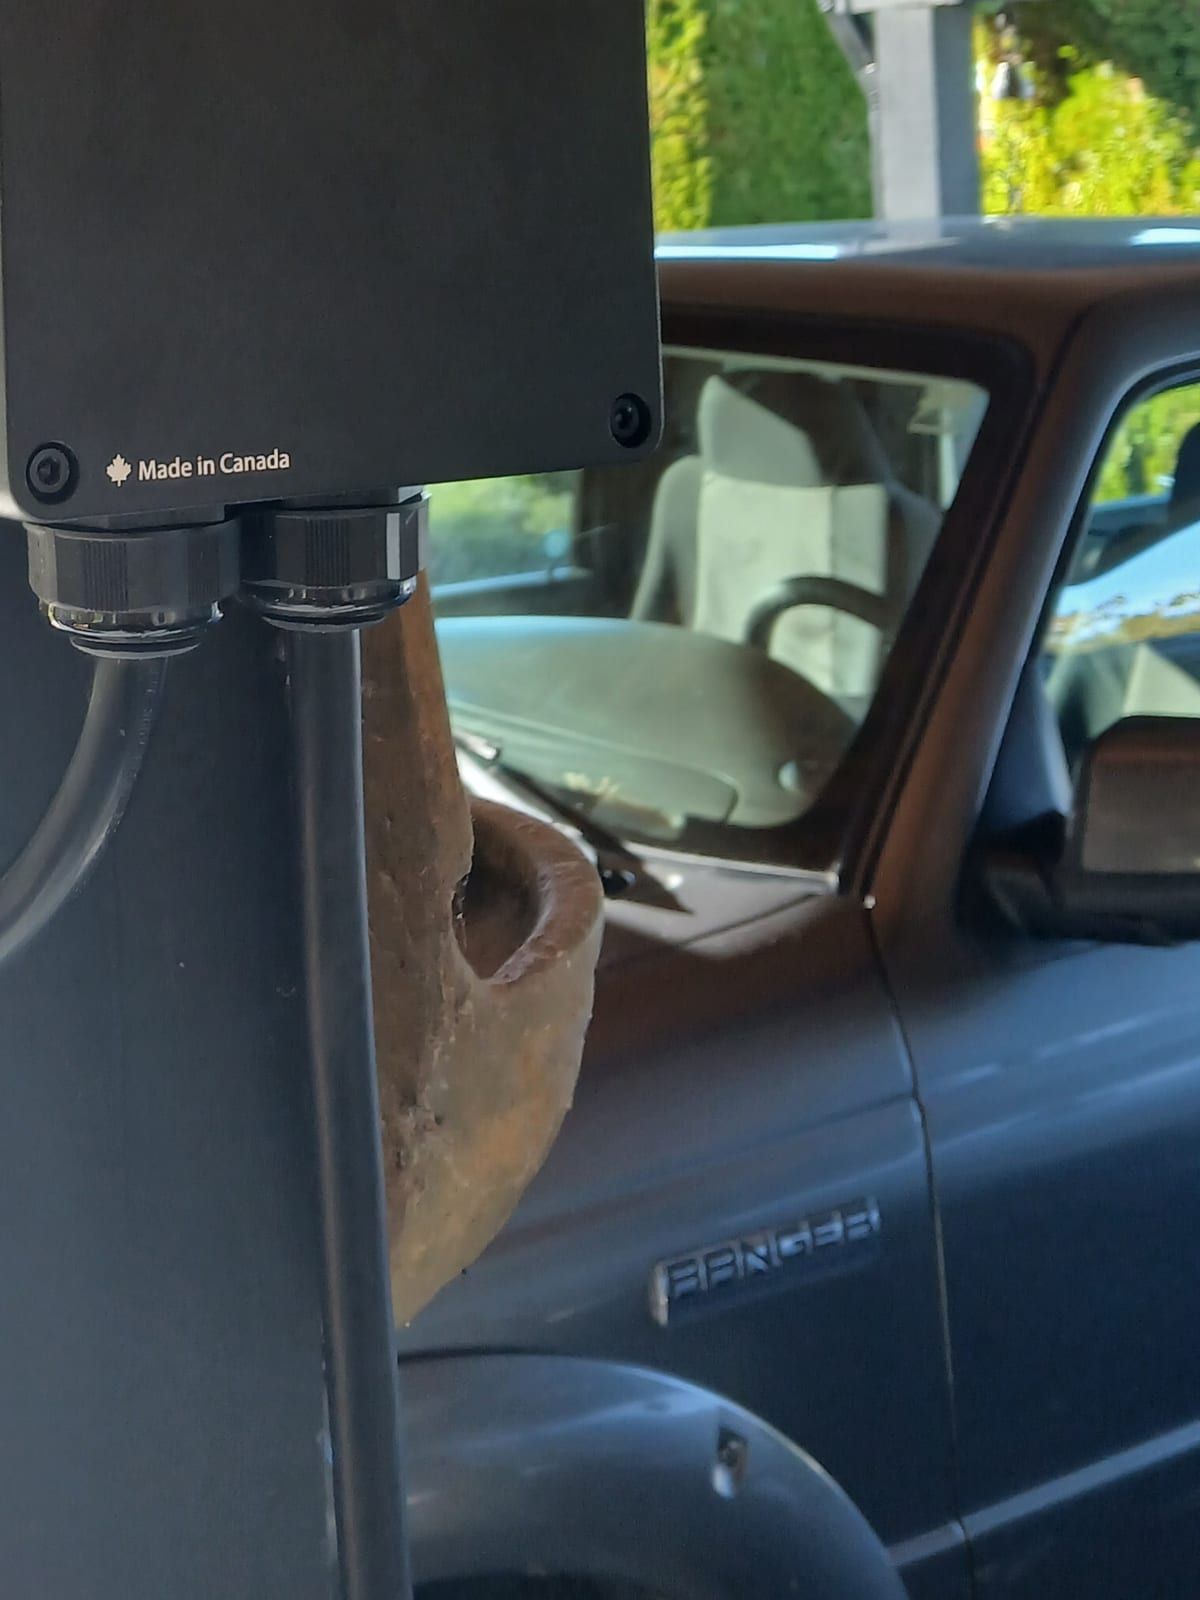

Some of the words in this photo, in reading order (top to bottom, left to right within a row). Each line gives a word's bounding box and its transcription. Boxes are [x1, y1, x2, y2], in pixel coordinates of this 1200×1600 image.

[138, 456, 193, 481] Made
[197, 455, 216, 476] in
[219, 448, 290, 475] Canada
